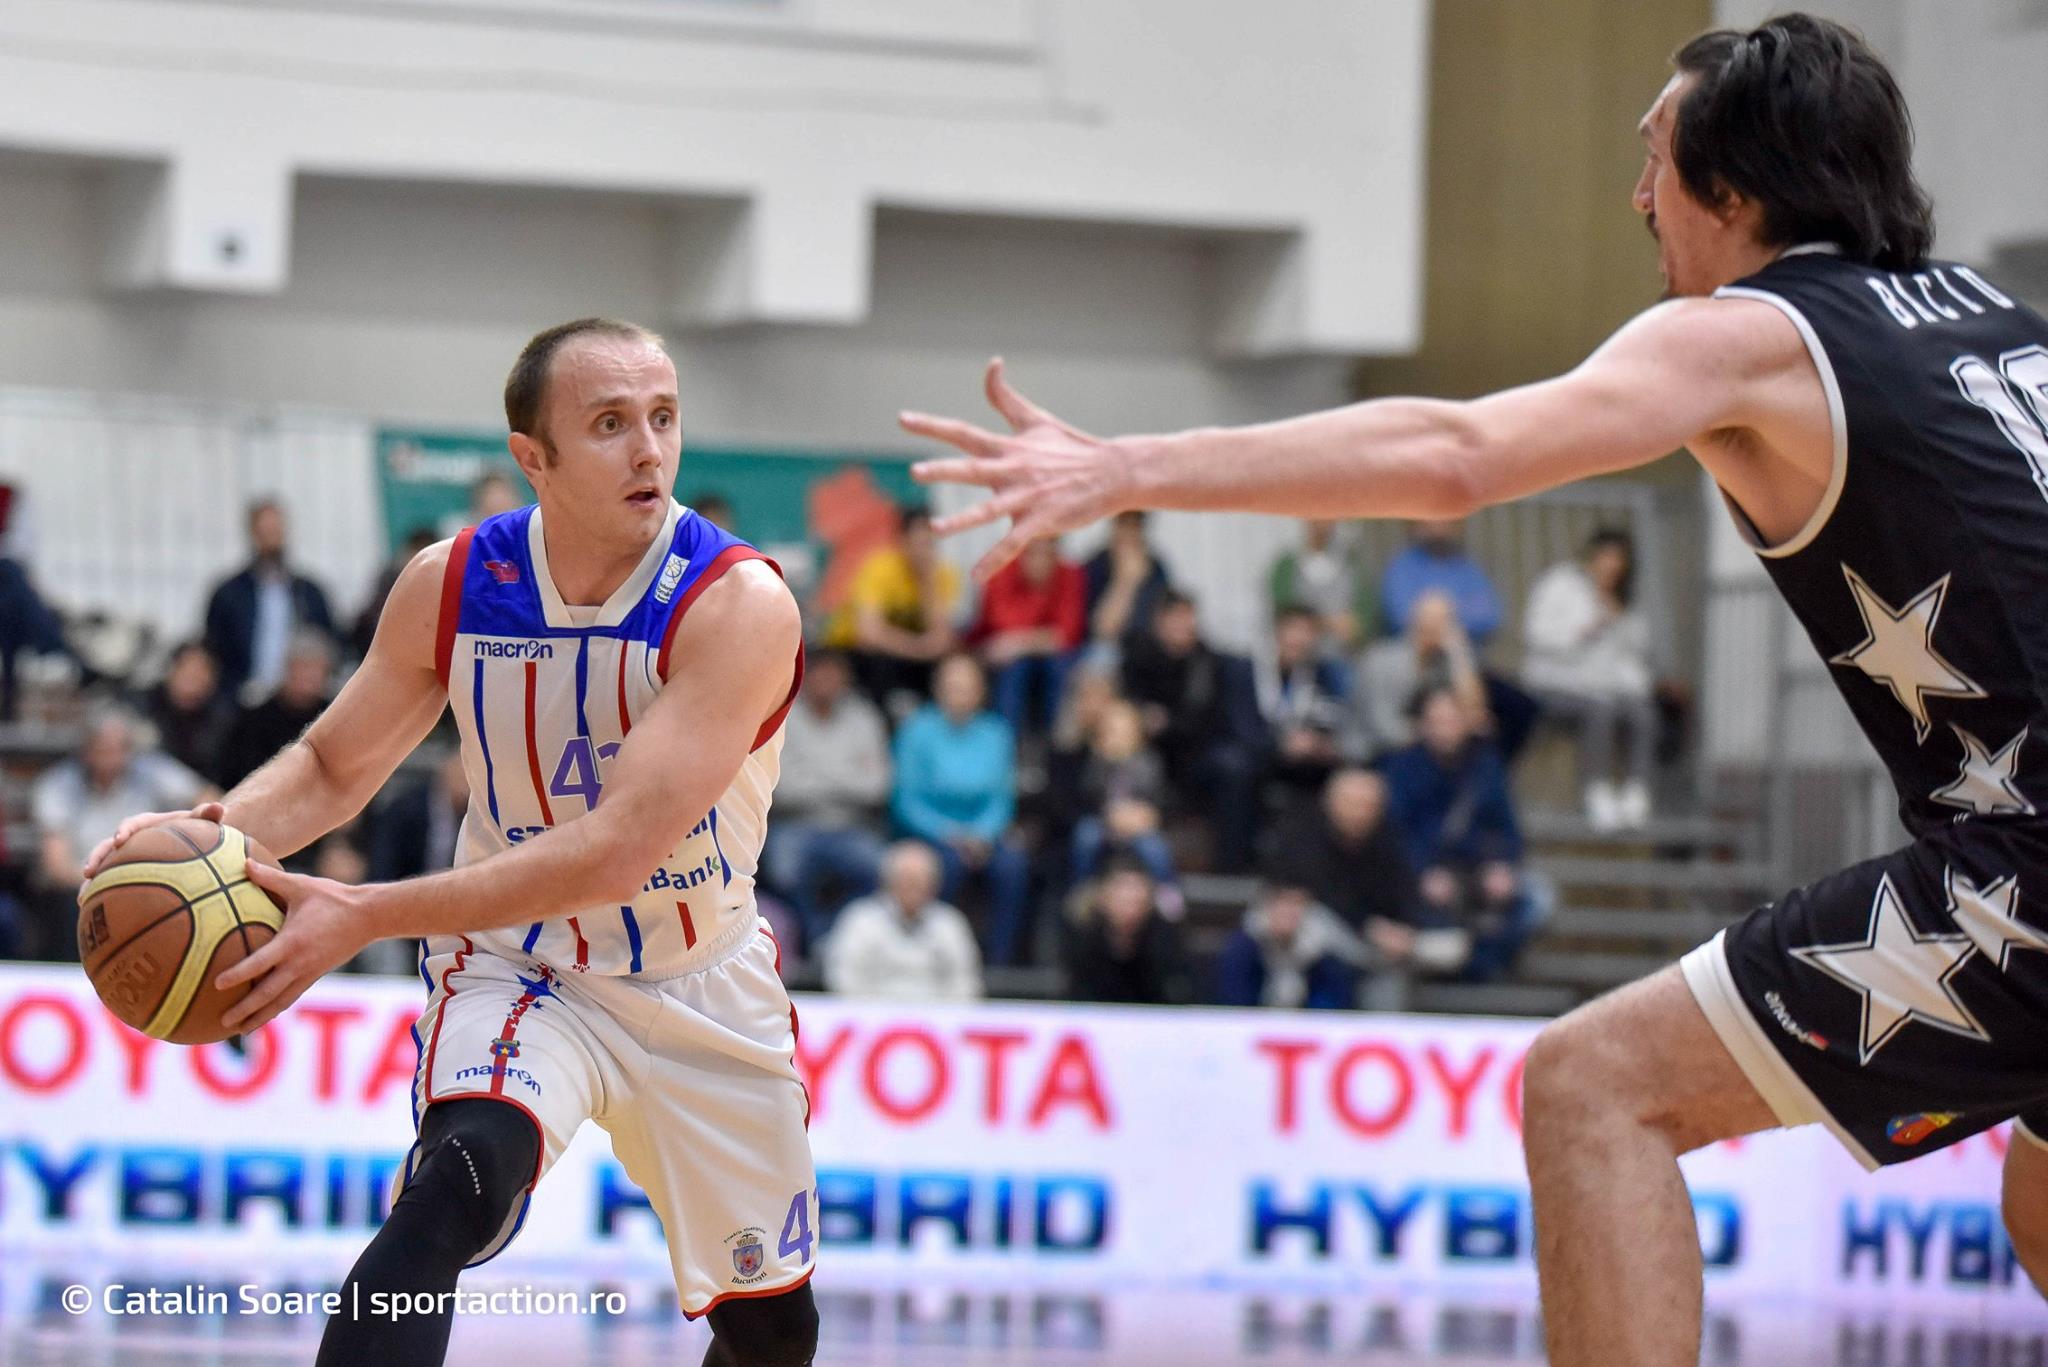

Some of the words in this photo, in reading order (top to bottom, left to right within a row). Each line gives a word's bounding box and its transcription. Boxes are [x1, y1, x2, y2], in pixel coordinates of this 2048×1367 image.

[474, 640, 553, 659] macron
[549, 736, 622, 812] 4
[644, 856, 721, 892] Bank
[0, 996, 422, 1104] OYOTA
[456, 1064, 541, 1096] macron
[797, 1022, 1114, 1132] YOTA
[1253, 1038, 1525, 1138] TOY
[777, 1188, 819, 1266] 4
[1843, 1198, 2016, 1286] HYB
